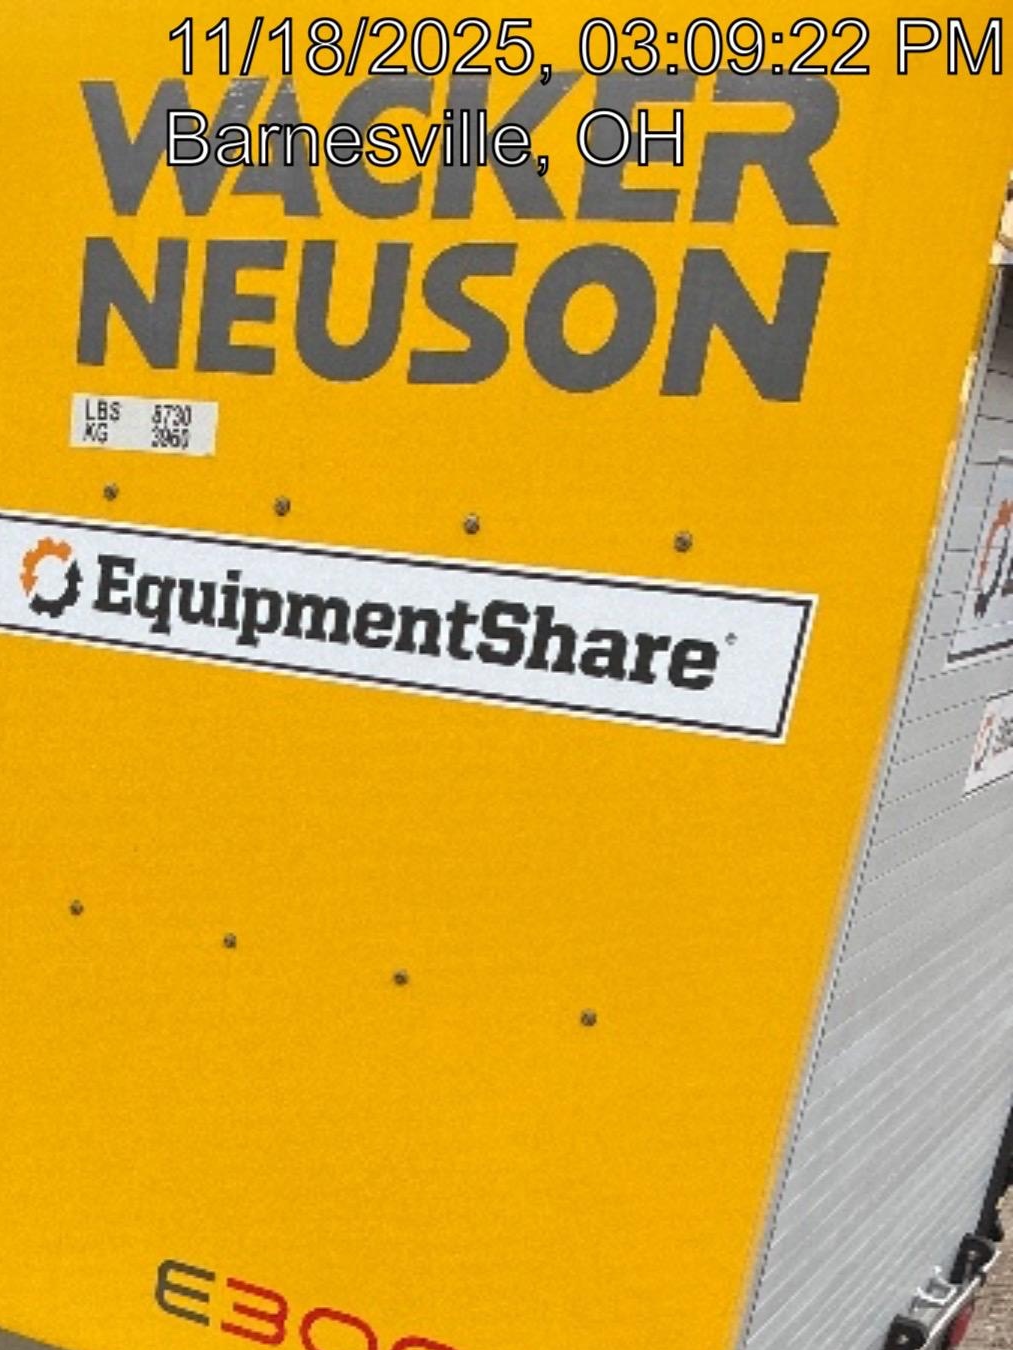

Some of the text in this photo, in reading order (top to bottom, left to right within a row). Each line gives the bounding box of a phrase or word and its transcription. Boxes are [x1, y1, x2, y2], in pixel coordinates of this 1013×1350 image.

[80, 68, 840, 225] WACKER
[76, 236, 830, 402] NEUSON
[83, 422, 109, 443] KG
[85, 399, 122, 422] LBS
[92, 554, 719, 691] EquipmentShare
